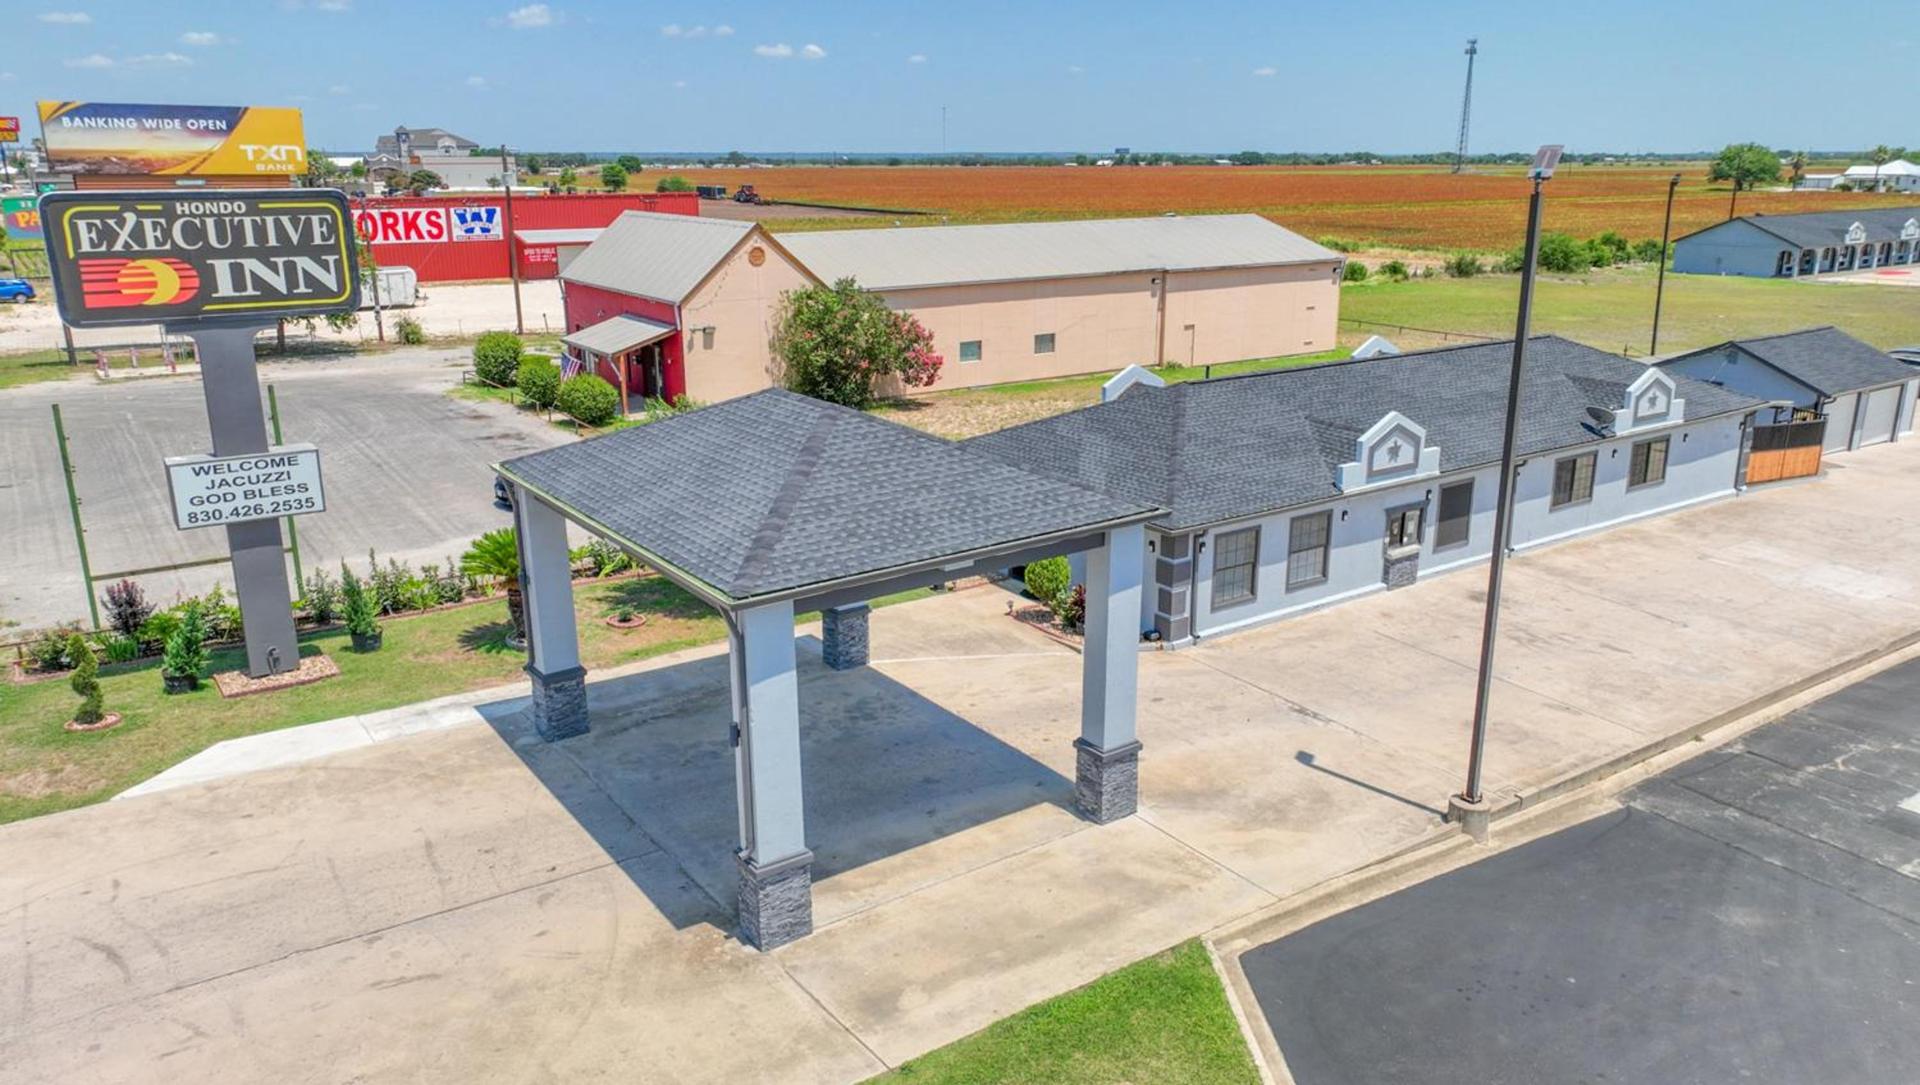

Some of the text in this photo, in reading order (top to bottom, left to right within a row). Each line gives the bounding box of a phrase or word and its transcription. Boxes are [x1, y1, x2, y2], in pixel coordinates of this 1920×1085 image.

[62, 116, 227, 131] BANKING WIDE OPEN
[255, 163, 296, 171] BANK
[175, 201, 247, 215] HONDO
[73, 211, 336, 252] EXECUTIVE
[351, 210, 444, 241] ORKS
[206, 255, 340, 298] INN
[192, 455, 300, 477] WELCOME
[205, 470, 292, 490] JACUZZI
[189, 482, 309, 507] GOD BLESS
[188, 497, 315, 524] 830.426.2535
